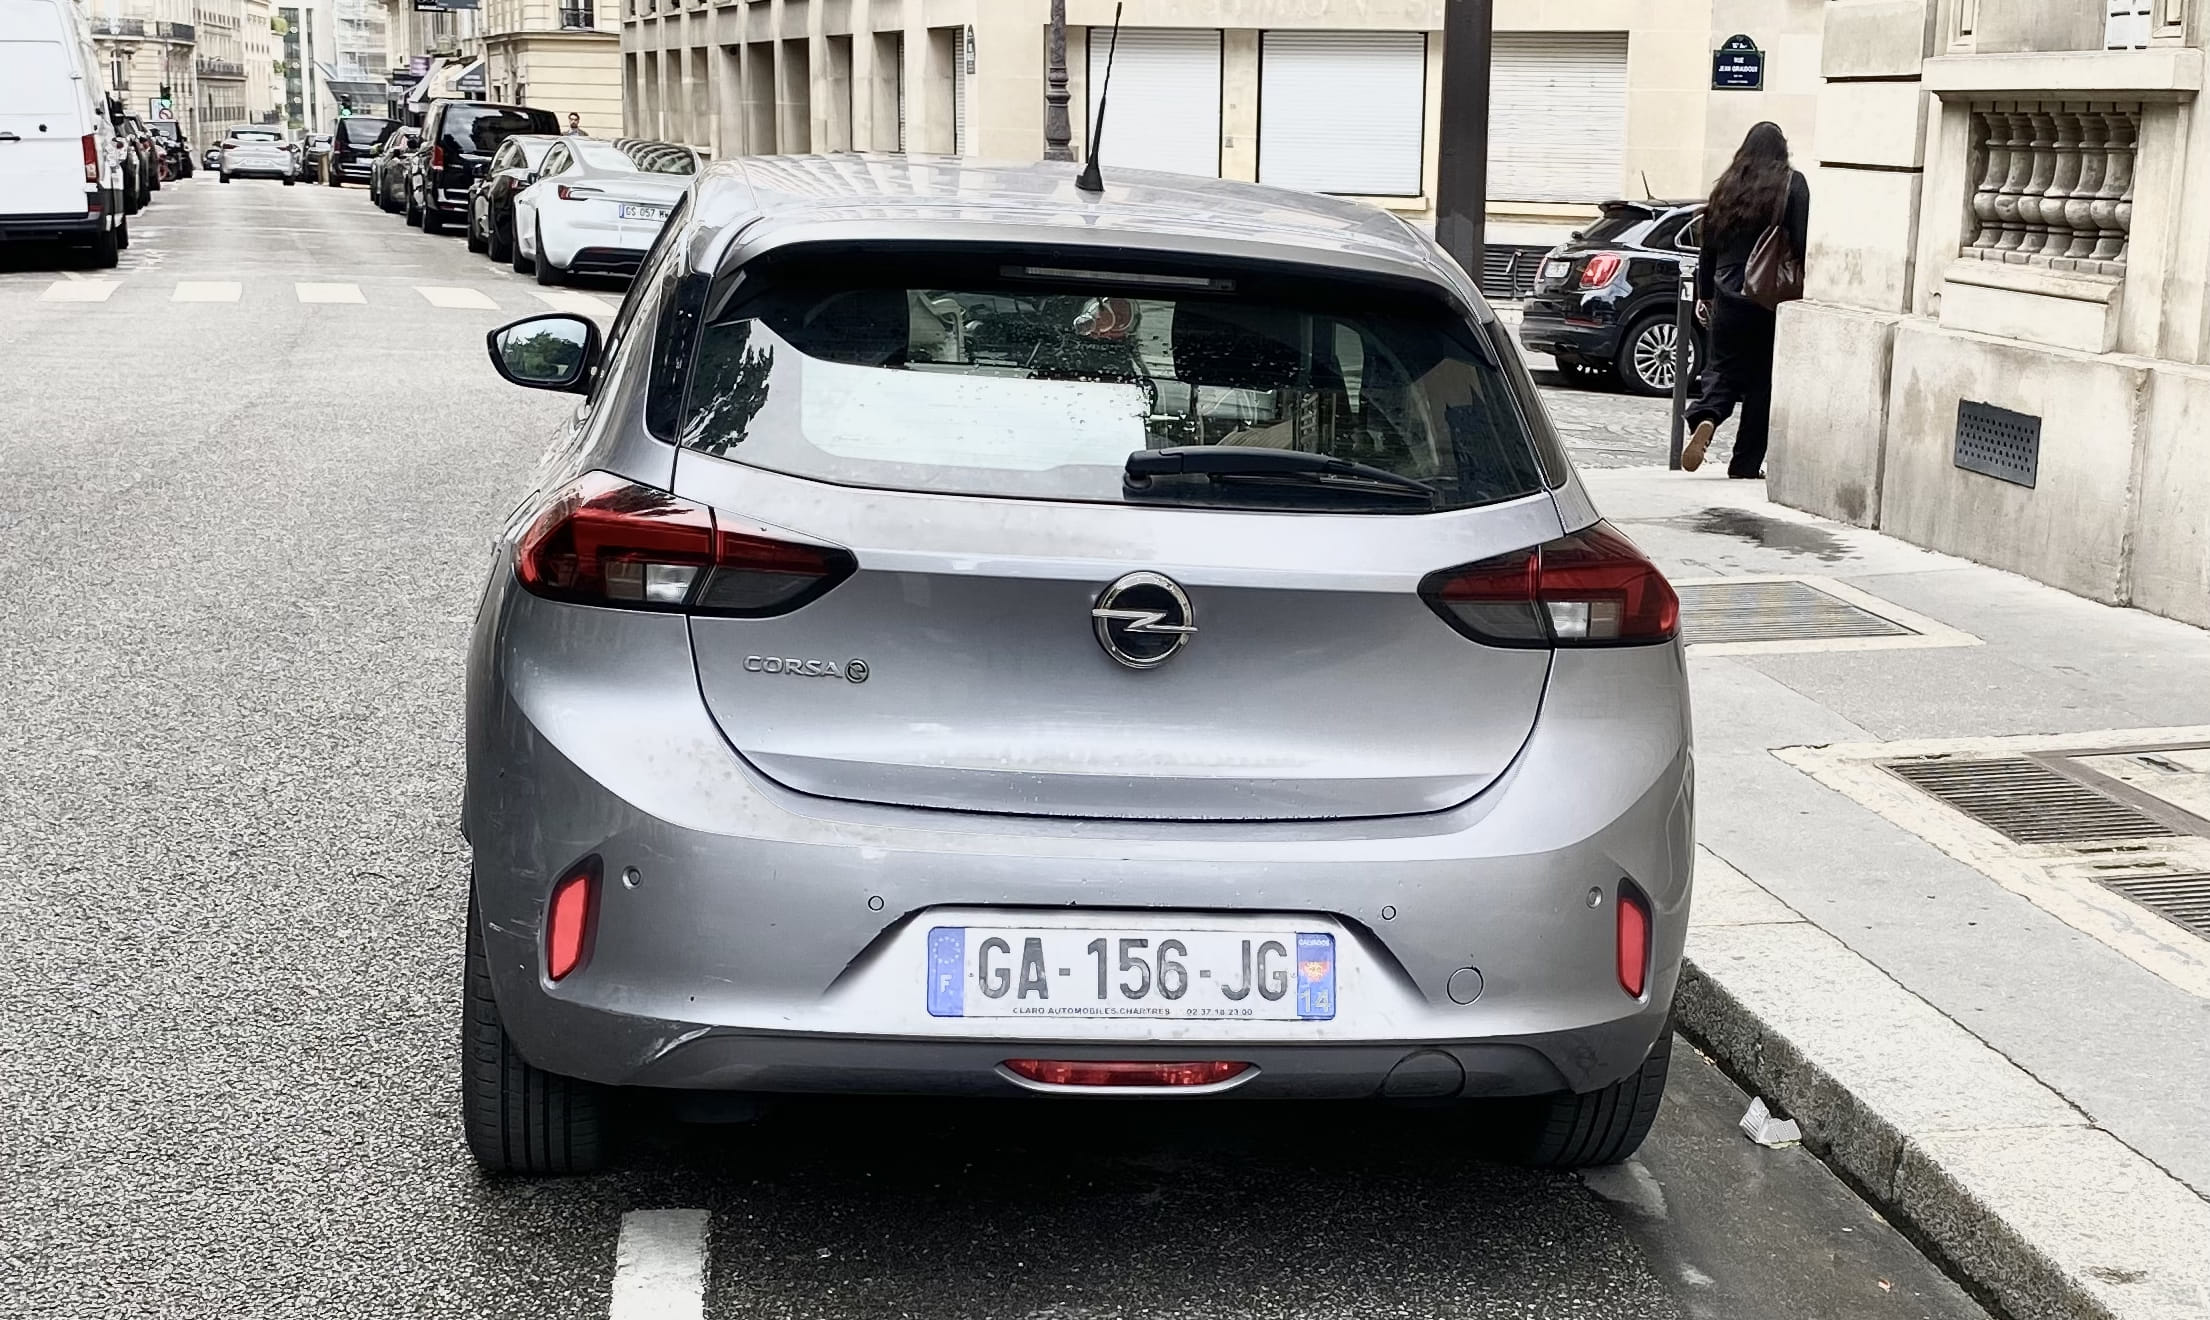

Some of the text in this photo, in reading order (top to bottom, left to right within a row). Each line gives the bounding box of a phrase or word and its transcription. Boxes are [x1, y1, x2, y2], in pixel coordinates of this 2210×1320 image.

[744, 655, 843, 679] CORSA
[940, 974, 953, 993] F
[1012, 1007, 1045, 1015] CLARO
[1300, 987, 1331, 1014] 14
